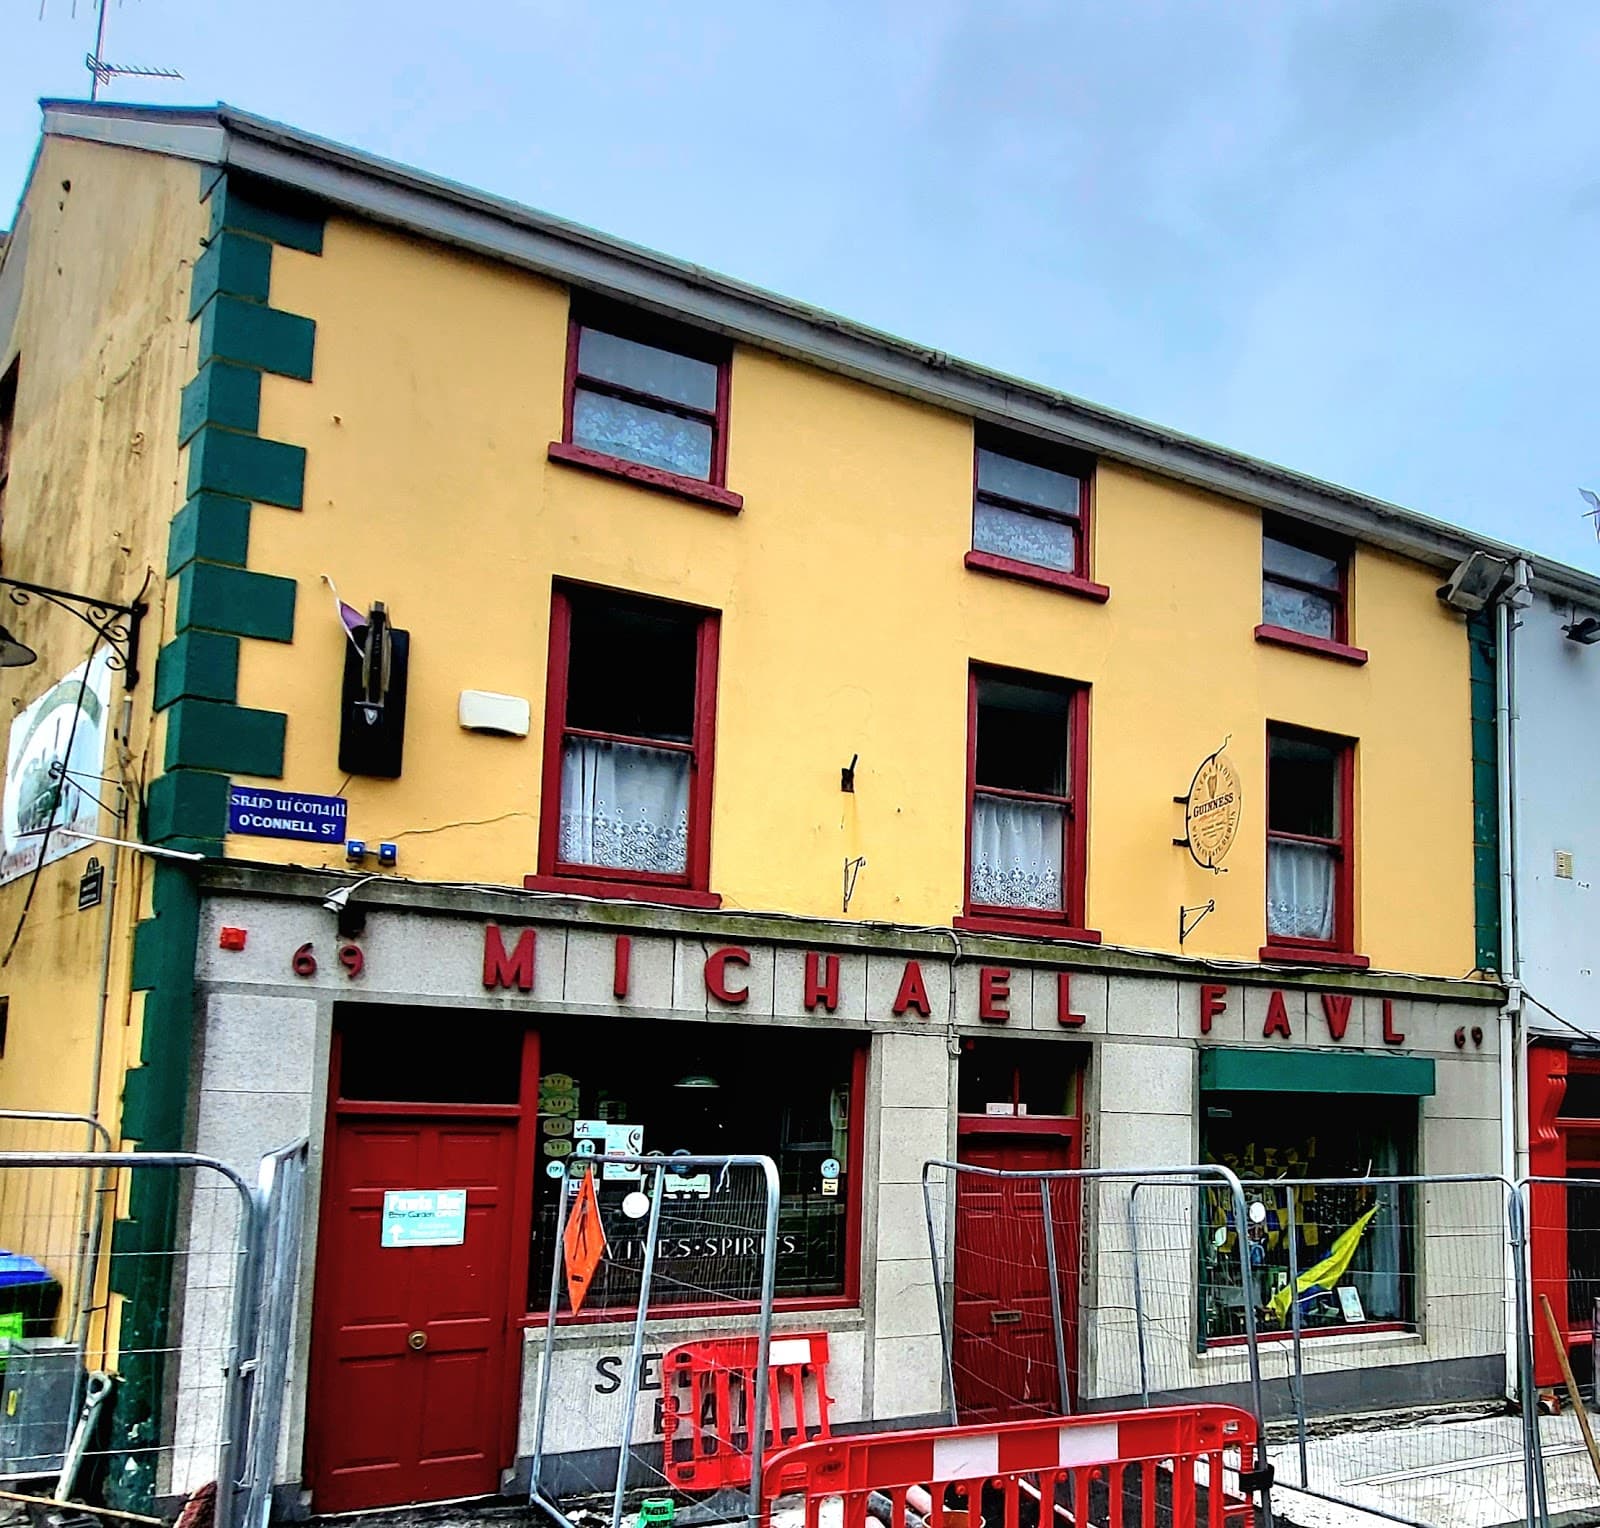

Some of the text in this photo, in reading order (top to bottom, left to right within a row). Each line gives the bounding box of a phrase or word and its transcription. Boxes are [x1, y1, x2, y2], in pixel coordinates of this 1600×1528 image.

[1193, 792, 1234, 818] GUINNESS
[238, 813, 317, 833] O'CONNELL
[482, 921, 1405, 1045] MICHAEL FAWL
[1083, 1112, 1092, 1160] OFF
[704, 1235, 795, 1257] SPIRIS
